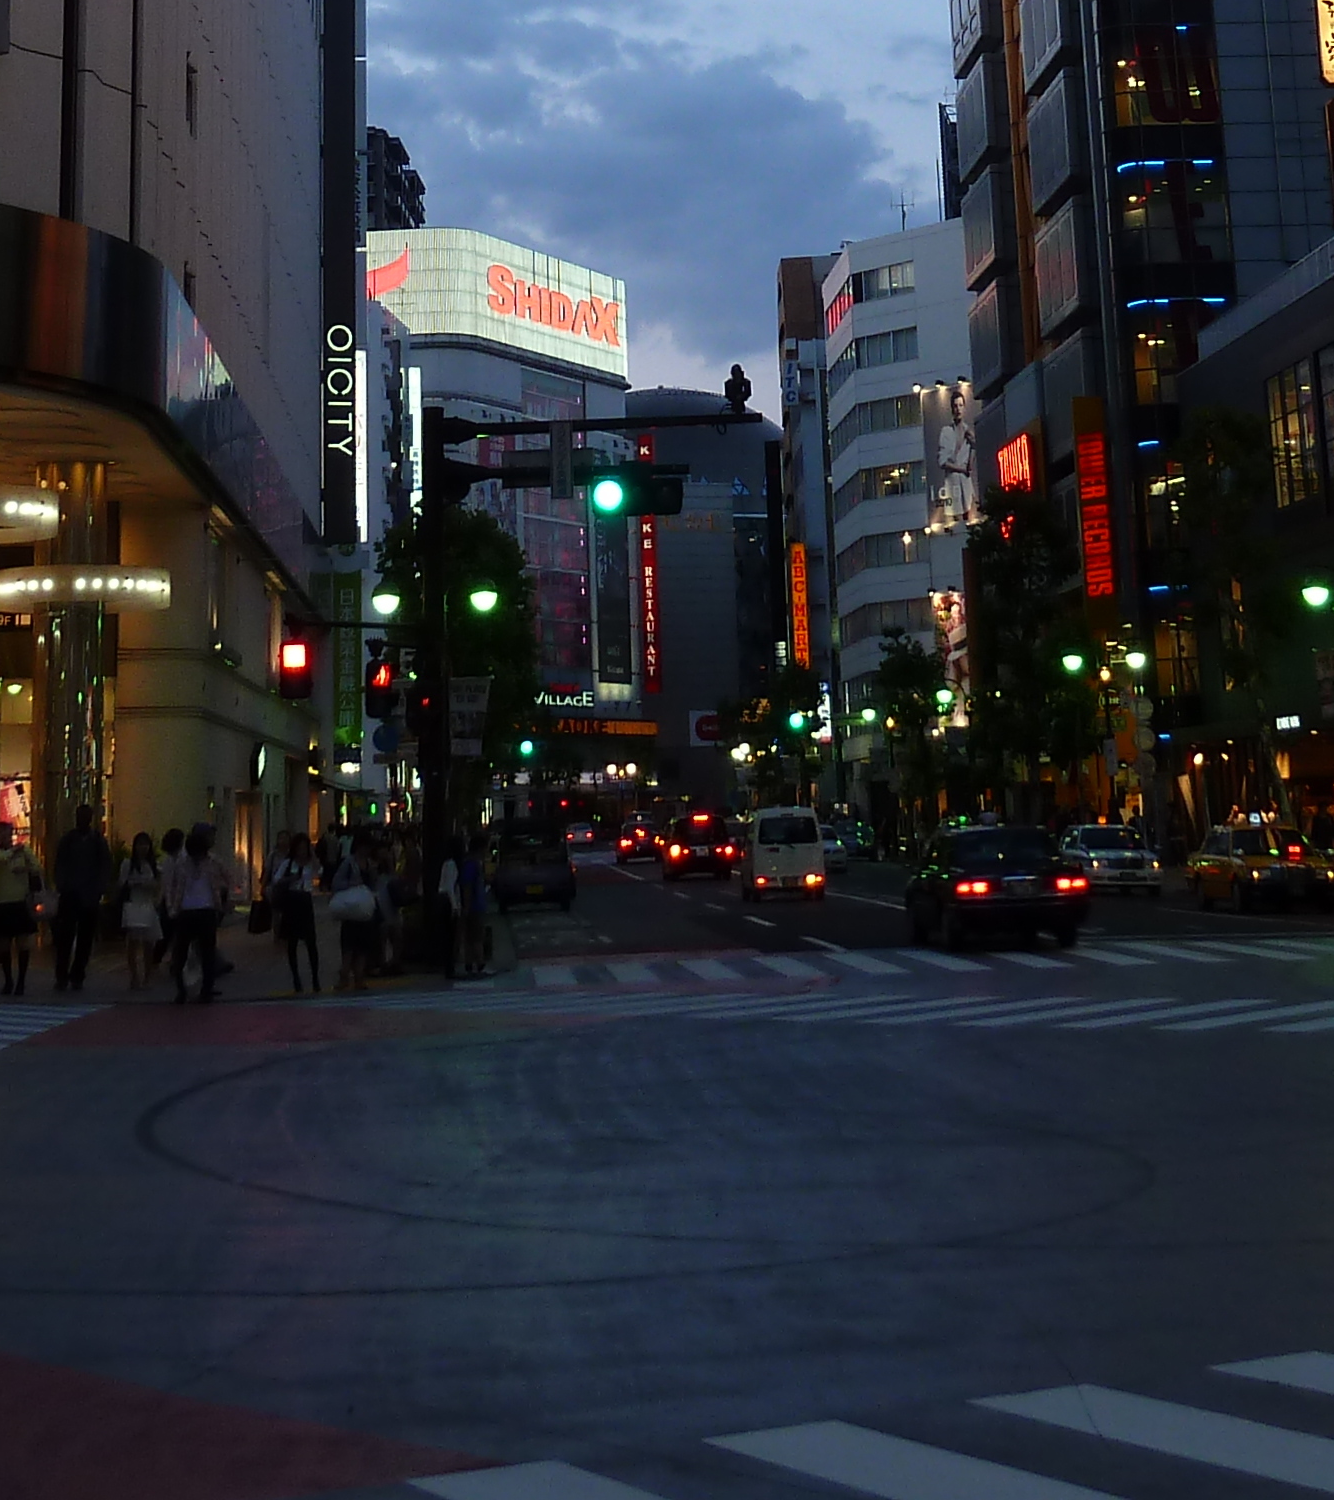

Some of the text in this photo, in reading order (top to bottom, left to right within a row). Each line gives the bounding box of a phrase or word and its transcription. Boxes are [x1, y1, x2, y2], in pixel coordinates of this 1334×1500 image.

[487, 264, 620, 347] SHIDAX
[325, 324, 354, 457] OICITY
[1082, 503, 1114, 598] RECORDS
[643, 566, 657, 678] RESTAURANT
